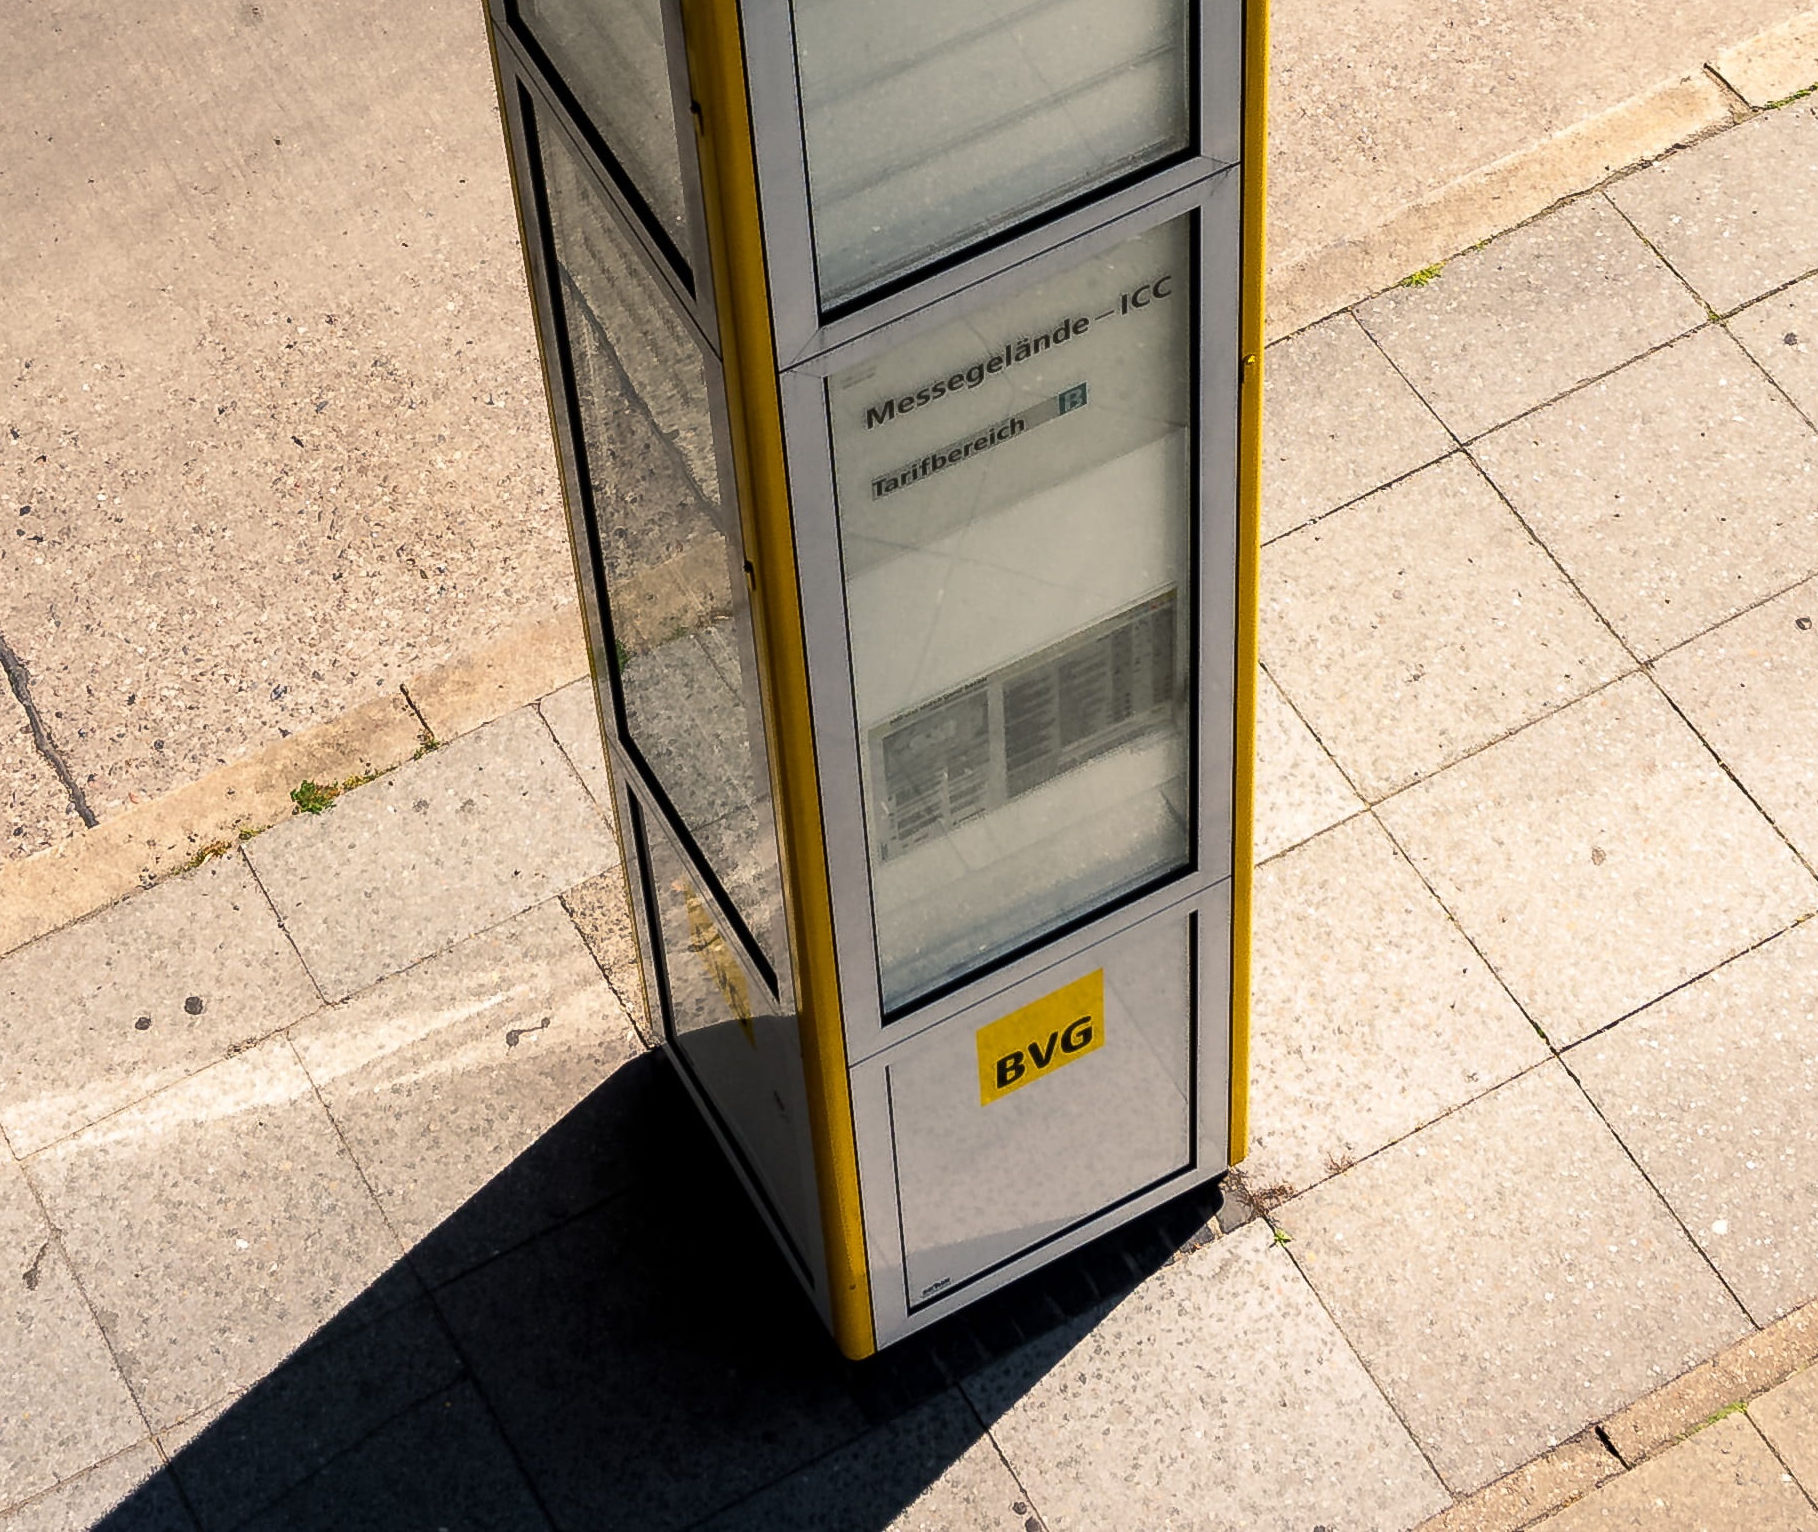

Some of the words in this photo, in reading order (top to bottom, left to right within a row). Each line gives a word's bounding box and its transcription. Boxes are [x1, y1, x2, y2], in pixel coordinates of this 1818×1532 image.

[864, 314, 1091, 431] Messegelände
[1118, 275, 1174, 317] ICC
[872, 415, 1026, 499] Tarifbereich
[996, 1015, 1094, 1089] BVG
